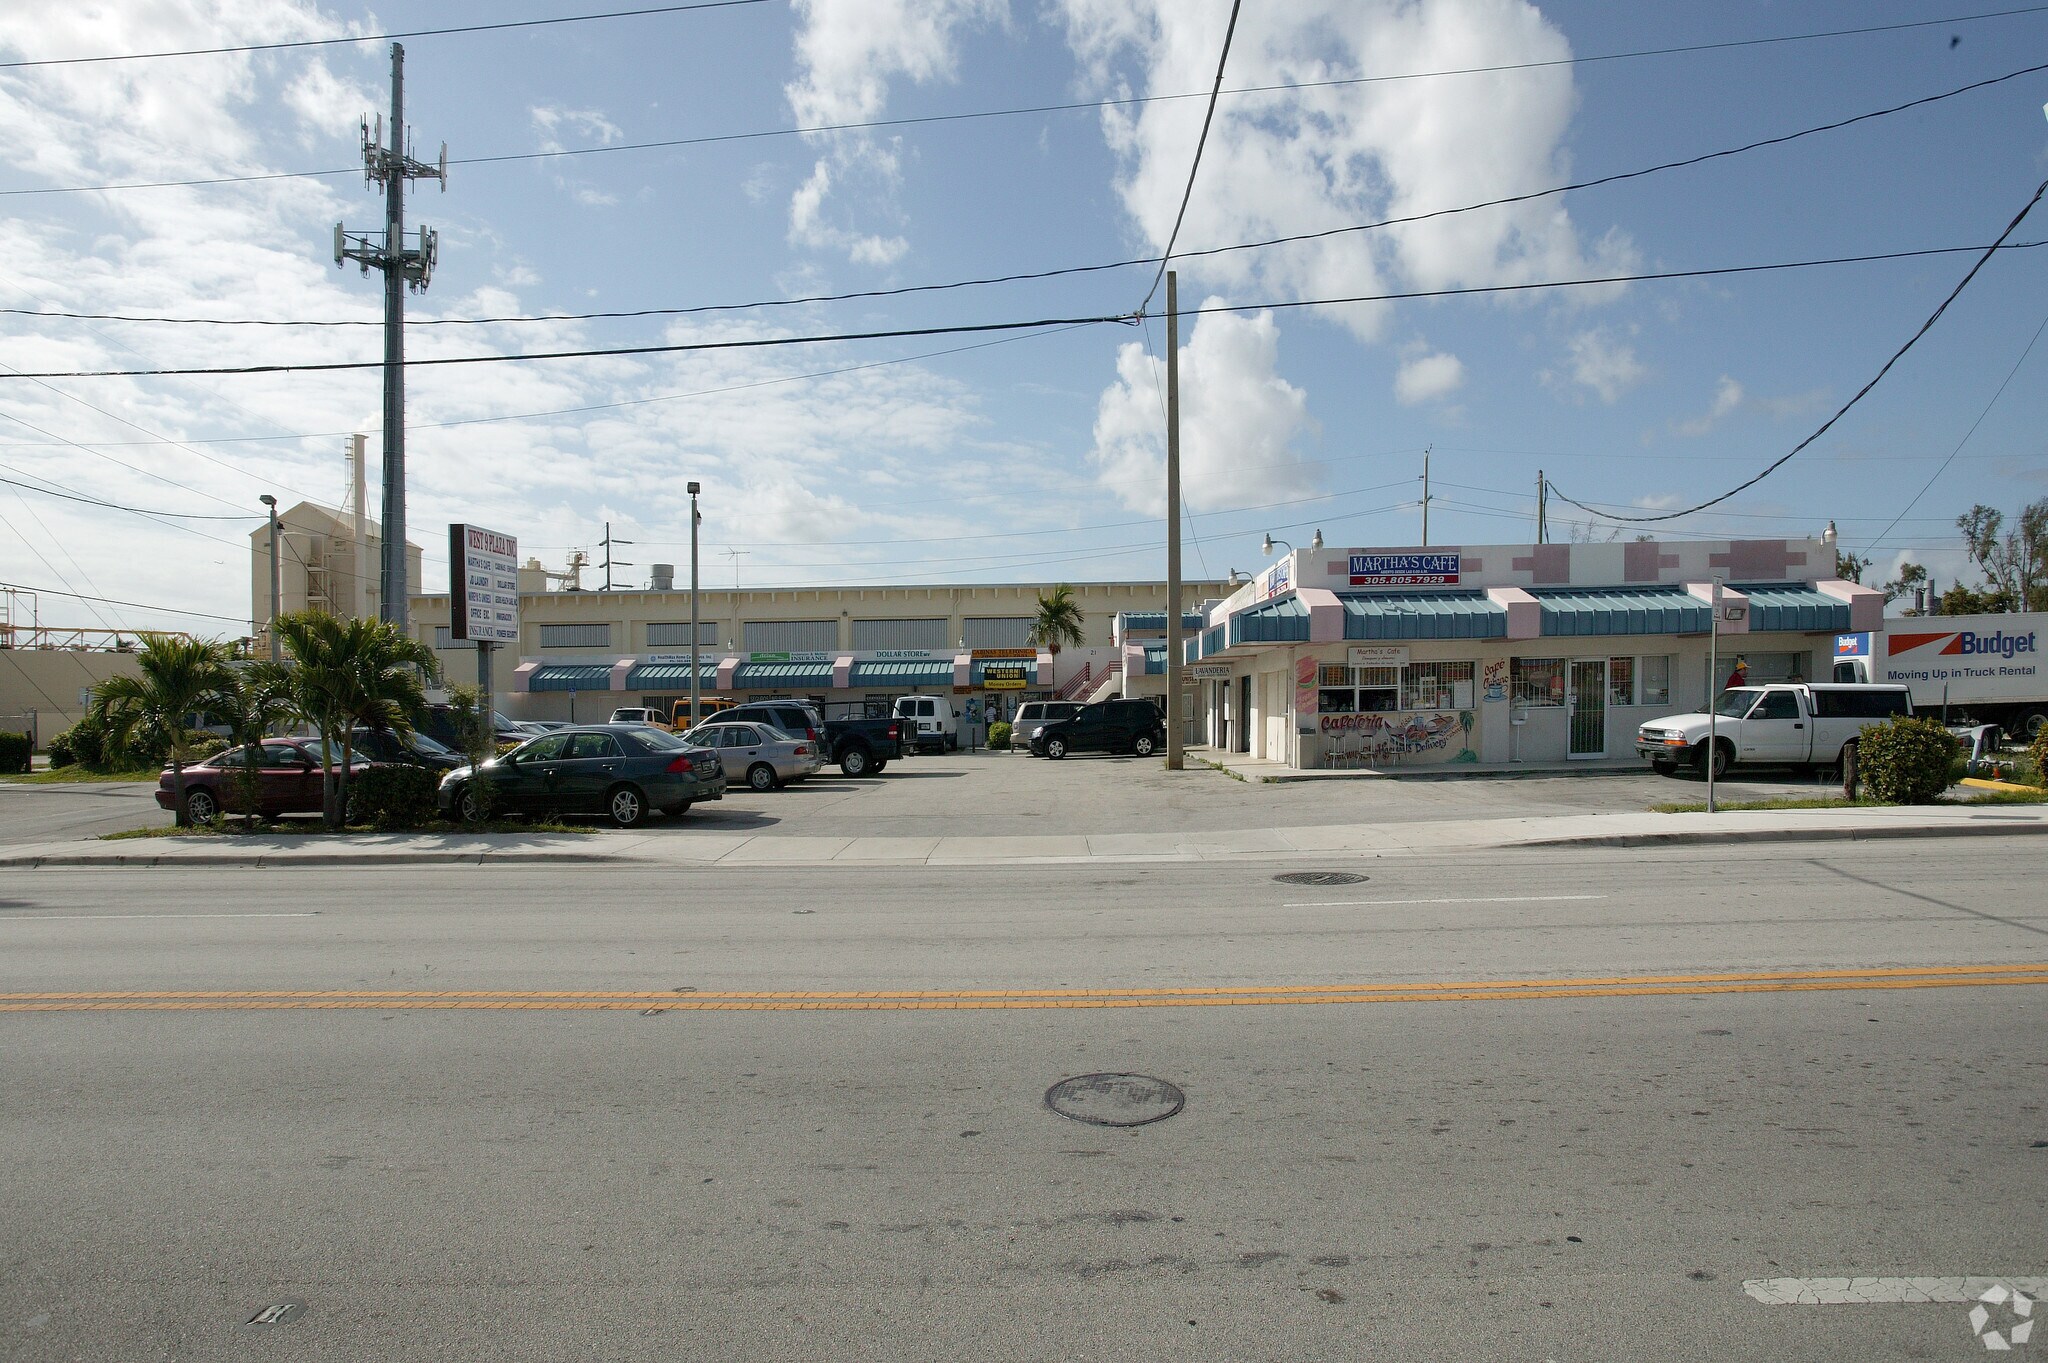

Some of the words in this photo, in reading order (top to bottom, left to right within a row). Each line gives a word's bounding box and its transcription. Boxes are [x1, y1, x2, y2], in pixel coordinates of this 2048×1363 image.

[468, 529, 483, 549] WEST
[484, 533, 489, 551] 9
[489, 535, 506, 555] PLAZA
[1352, 556, 1420, 572] MARTHA'S
[1422, 556, 1457, 571] CAFE
[1364, 576, 1444, 584] 305.805-7929
[470, 608, 482, 618] OFFICE
[469, 625, 493, 637] INSURANCE
[1838, 636, 1858, 648] Budget
[1961, 632, 2036, 658] Budget
[1484, 658, 1505, 678] Café
[1888, 670, 1928, 680] Moving
[1932, 668, 1948, 680] Up
[1951, 667, 1962, 677] in
[1964, 667, 1995, 677] Truck
[1999, 666, 2036, 676] Rental
[1321, 714, 1384, 730] Cafeteria
[1415, 738, 1448, 753] Delivery
